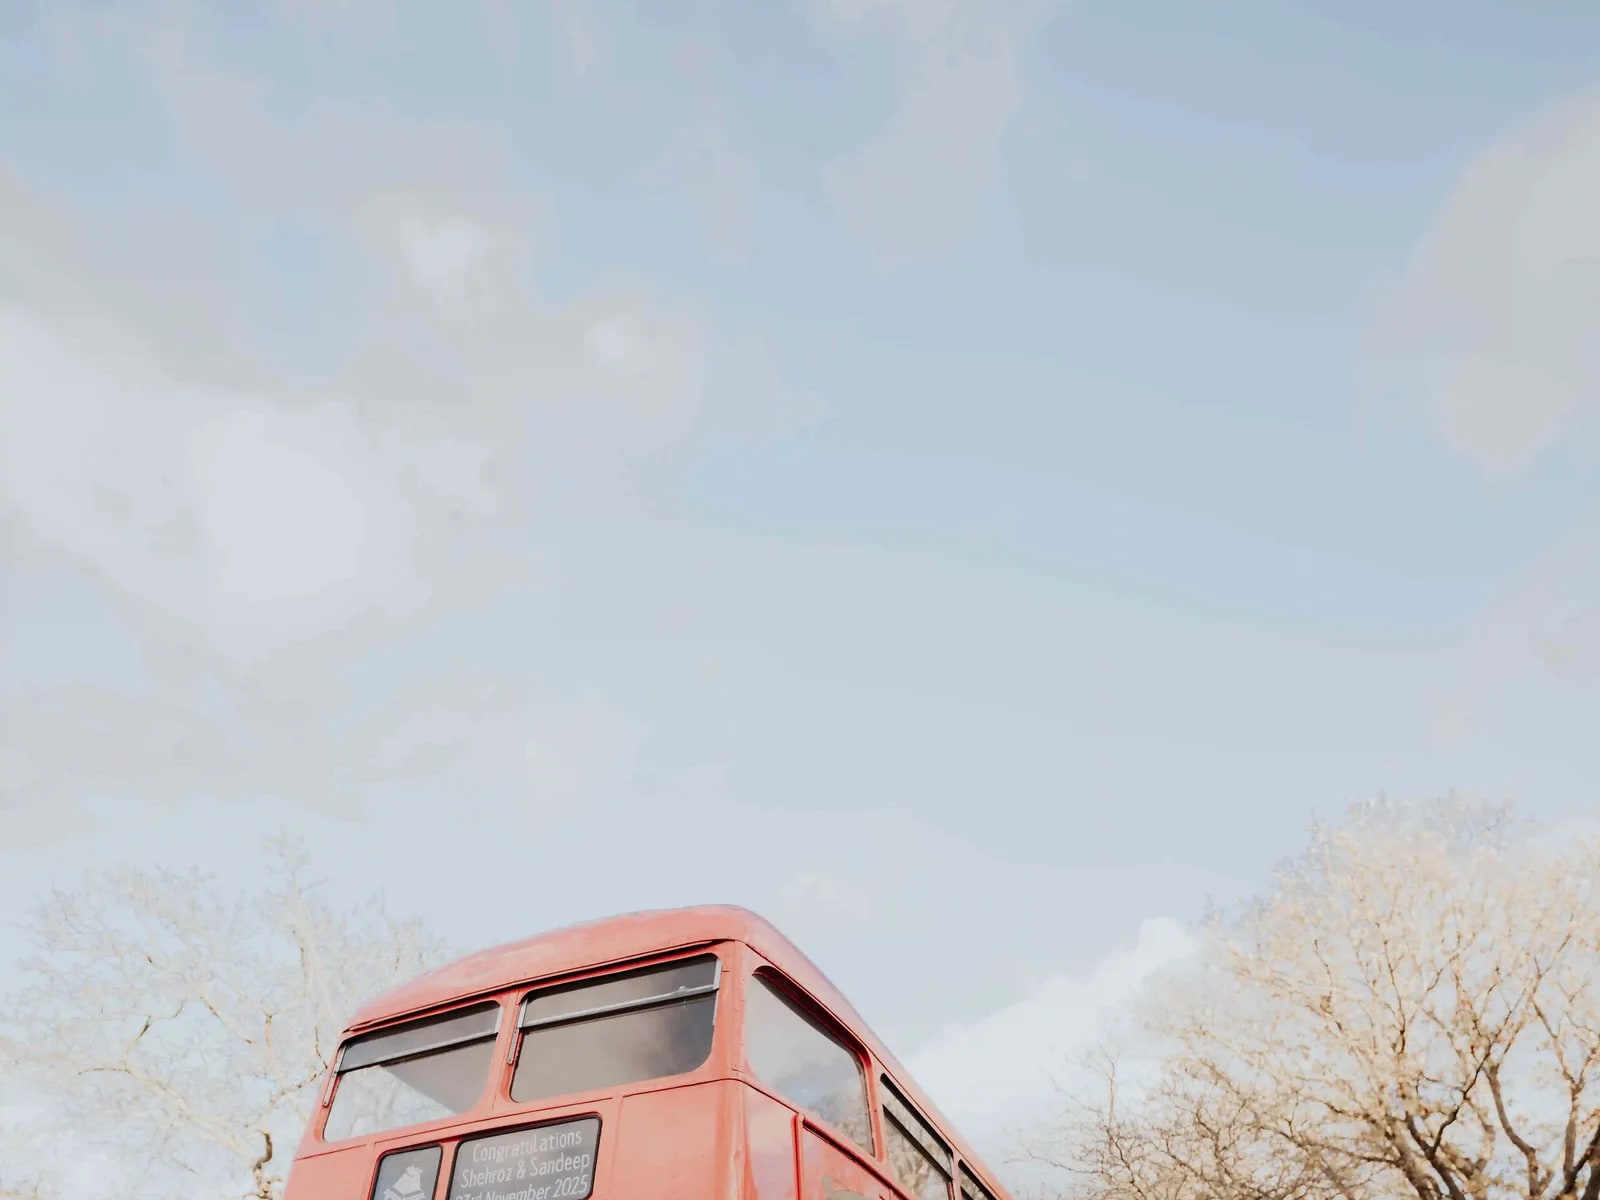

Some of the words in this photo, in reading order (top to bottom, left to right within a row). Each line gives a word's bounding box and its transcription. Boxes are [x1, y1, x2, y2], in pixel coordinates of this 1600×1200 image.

[472, 1131, 582, 1163] Congratulations
[461, 1167, 513, 1189] Shehroz
[516, 1160, 526, 1180] &
[530, 1152, 591, 1177] Sandeep
[552, 1174, 589, 1198] 2025
